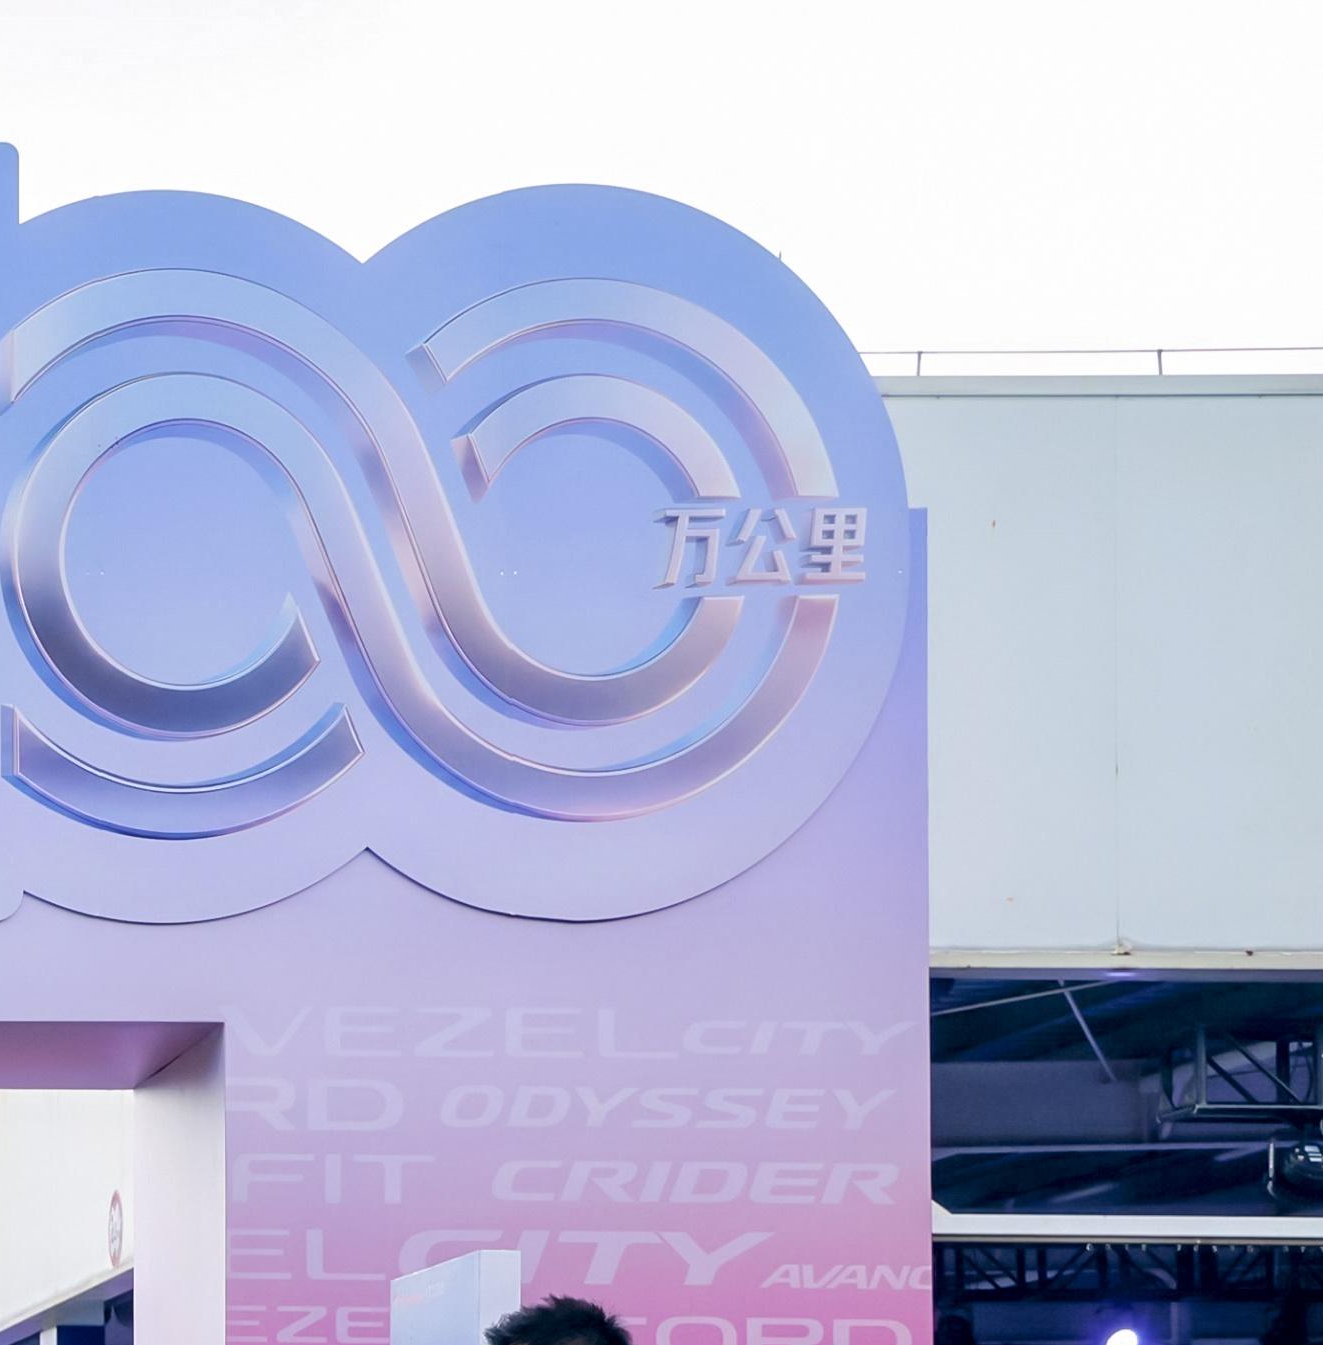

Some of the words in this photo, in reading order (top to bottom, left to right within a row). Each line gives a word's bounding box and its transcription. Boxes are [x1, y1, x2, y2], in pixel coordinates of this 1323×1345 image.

[653, 504, 868, 590] 万公里
[219, 1007, 678, 1060] VEZEL
[681, 1018, 918, 1057] CITY
[439, 1083, 897, 1132] ODYSSEY
[230, 1153, 436, 1206] FIT
[489, 1160, 901, 1206] CRIDER
